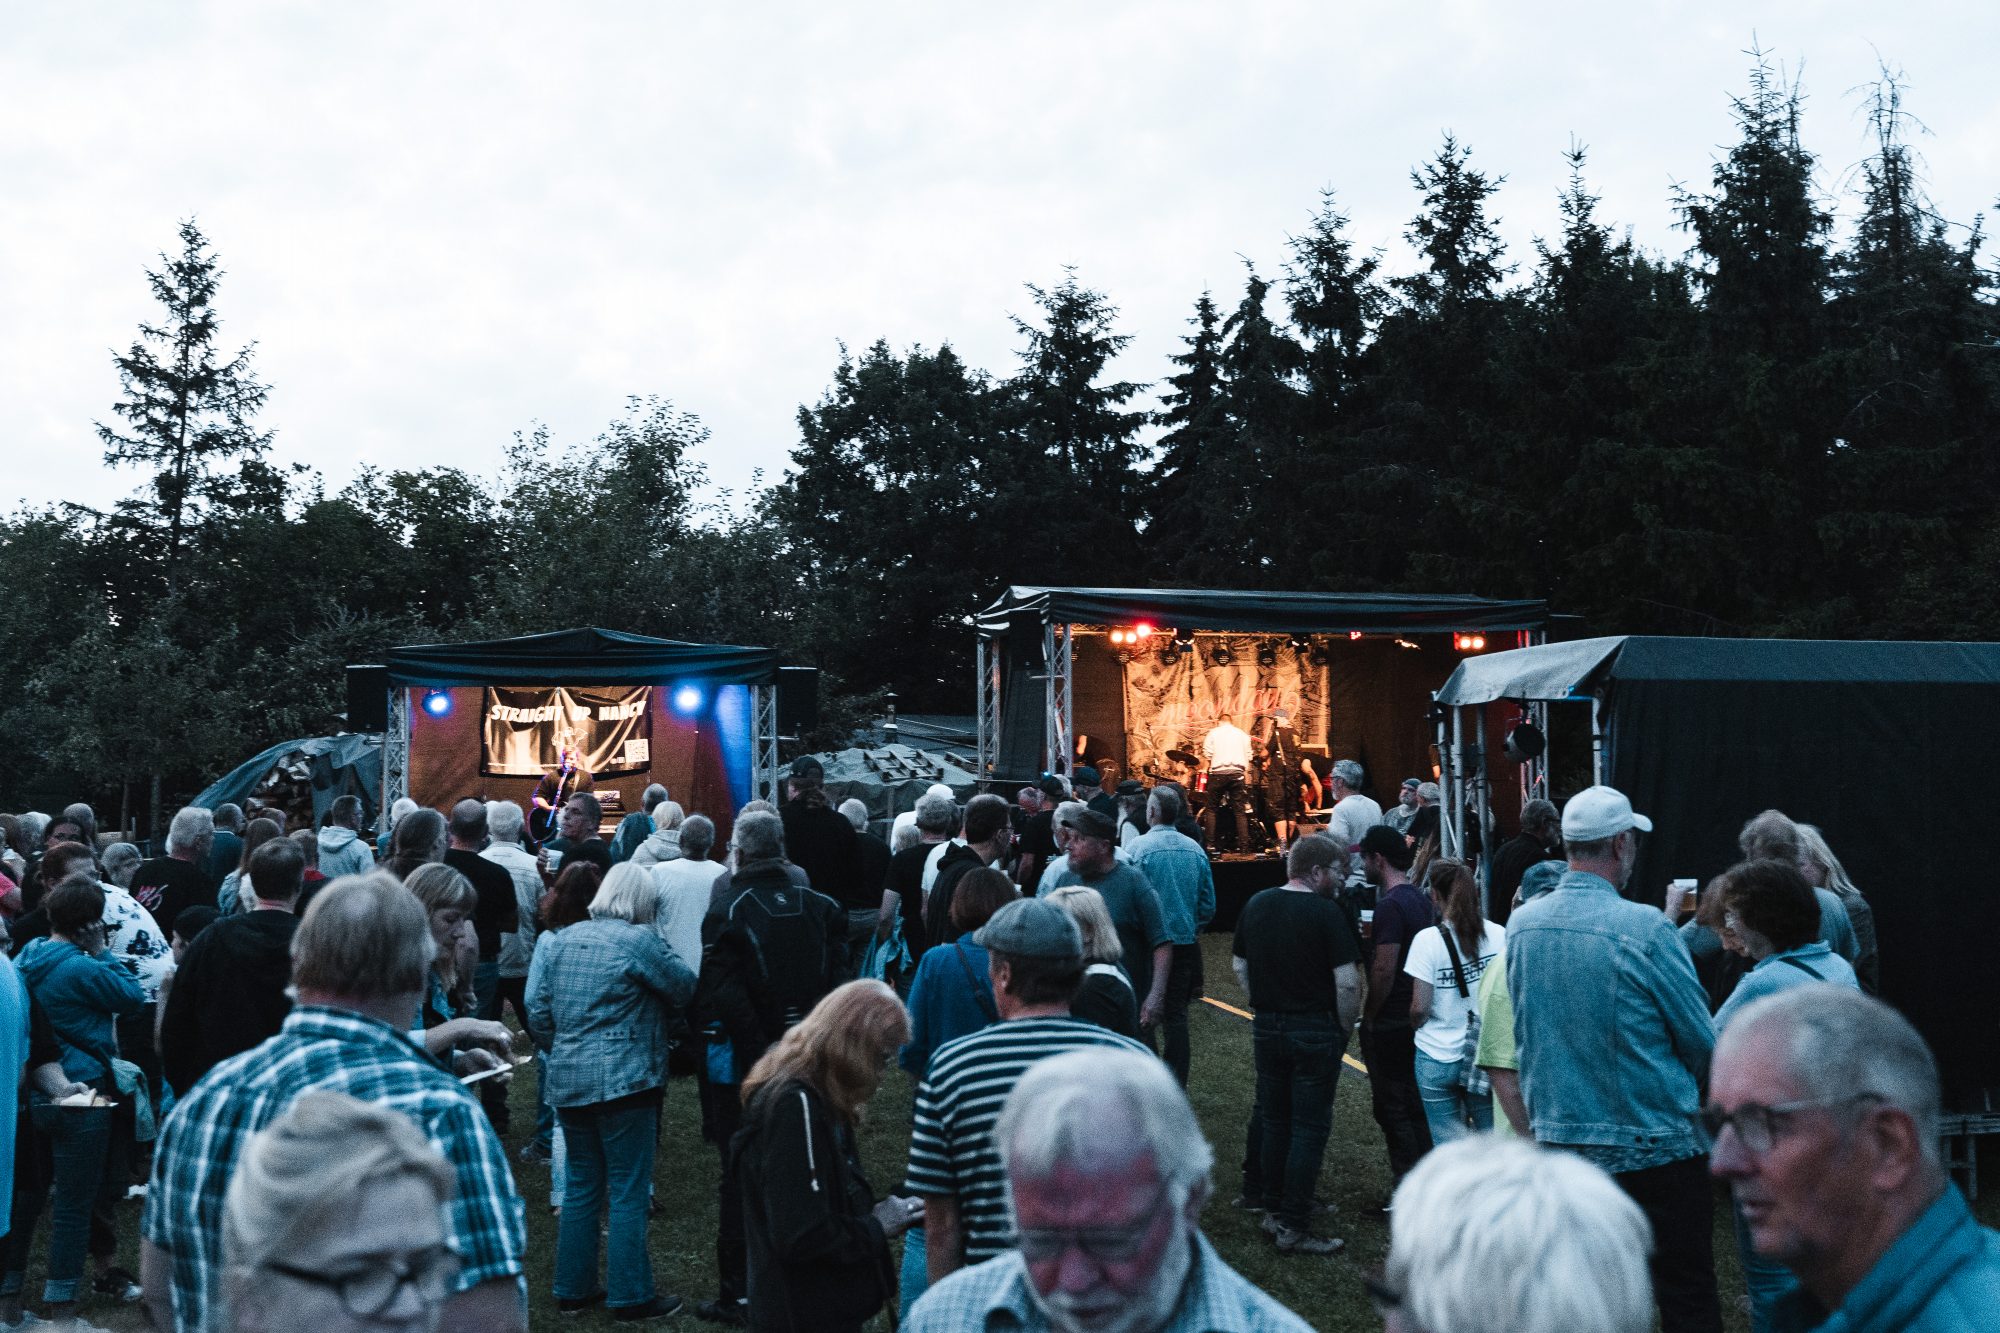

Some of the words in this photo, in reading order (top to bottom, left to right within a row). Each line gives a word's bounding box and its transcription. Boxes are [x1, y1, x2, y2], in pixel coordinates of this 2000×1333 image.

[491, 704, 565, 723] STRAIGHT
[572, 705, 592, 722] UP
[598, 700, 647, 721] NANCY
